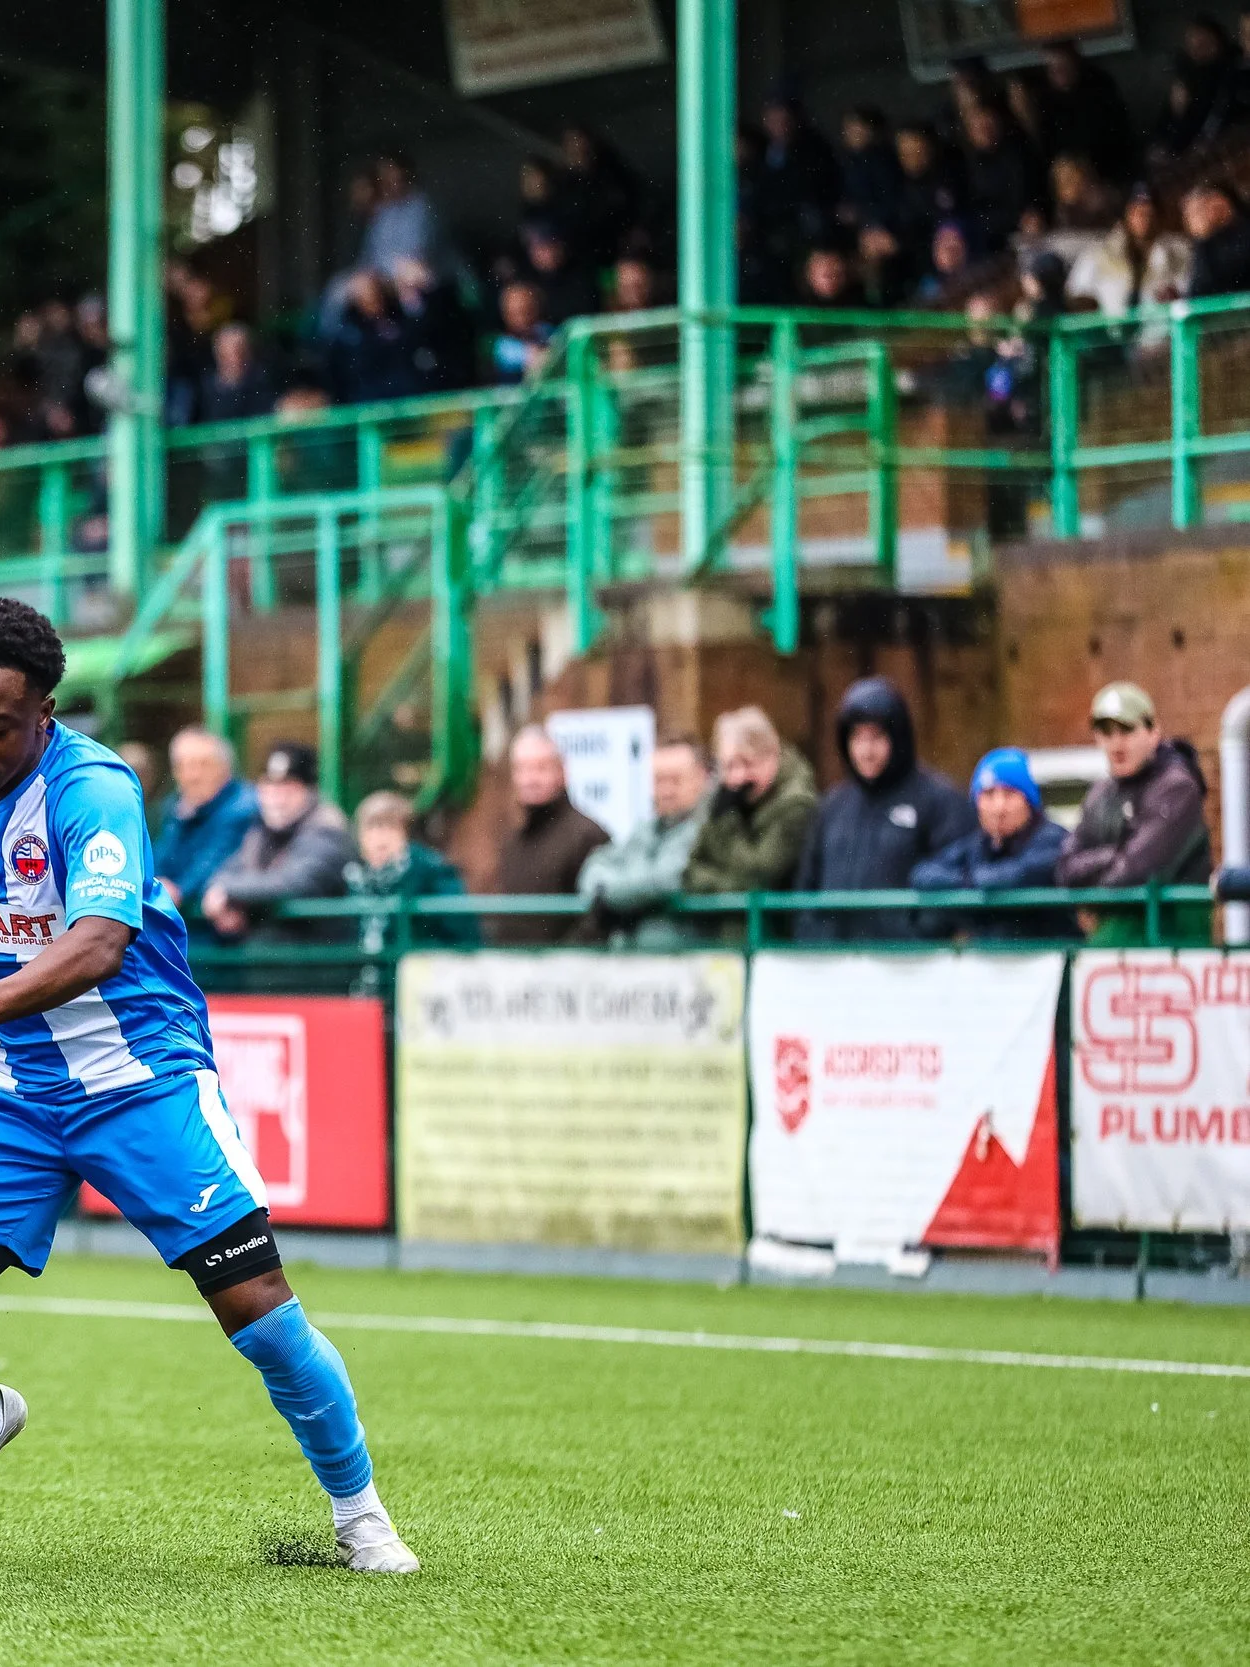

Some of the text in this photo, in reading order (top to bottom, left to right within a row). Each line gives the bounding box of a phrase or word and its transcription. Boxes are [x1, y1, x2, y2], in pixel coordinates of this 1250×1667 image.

[86, 886, 127, 901] SERVICES
[11, 937, 54, 946] SUPPLIES
[224, 1235, 269, 1259] Sondico
